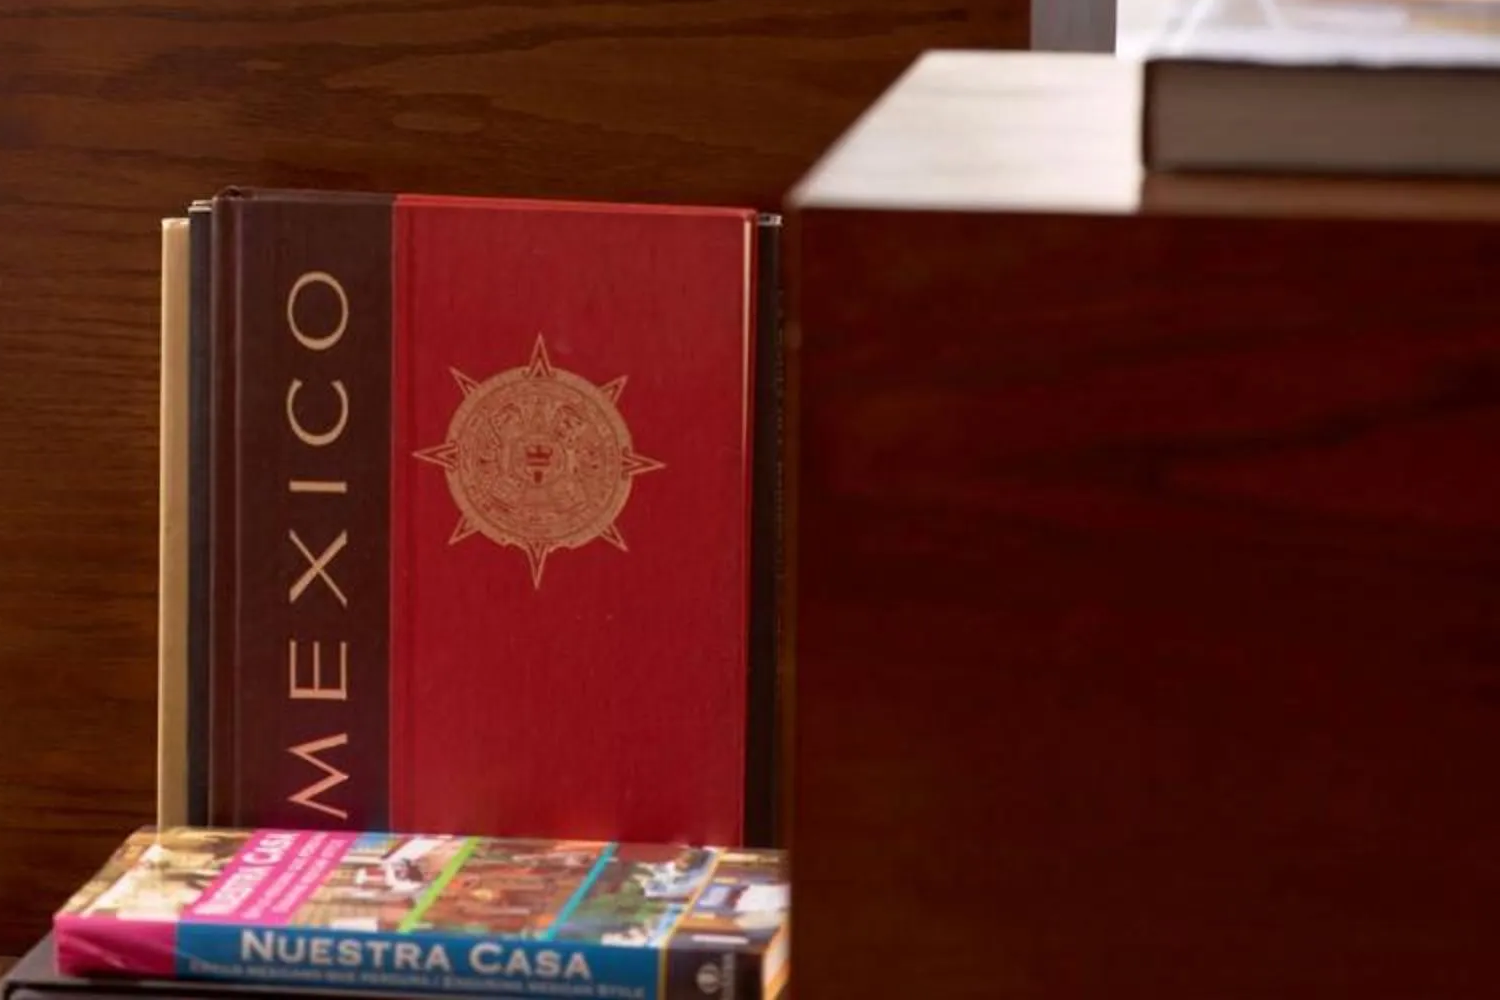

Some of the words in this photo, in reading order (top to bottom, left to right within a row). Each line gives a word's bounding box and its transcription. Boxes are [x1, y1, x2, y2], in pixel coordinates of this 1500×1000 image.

[286, 270, 349, 820] MEXICO
[240, 929, 450, 971] NUESTRA
[469, 942, 591, 980] CASA
